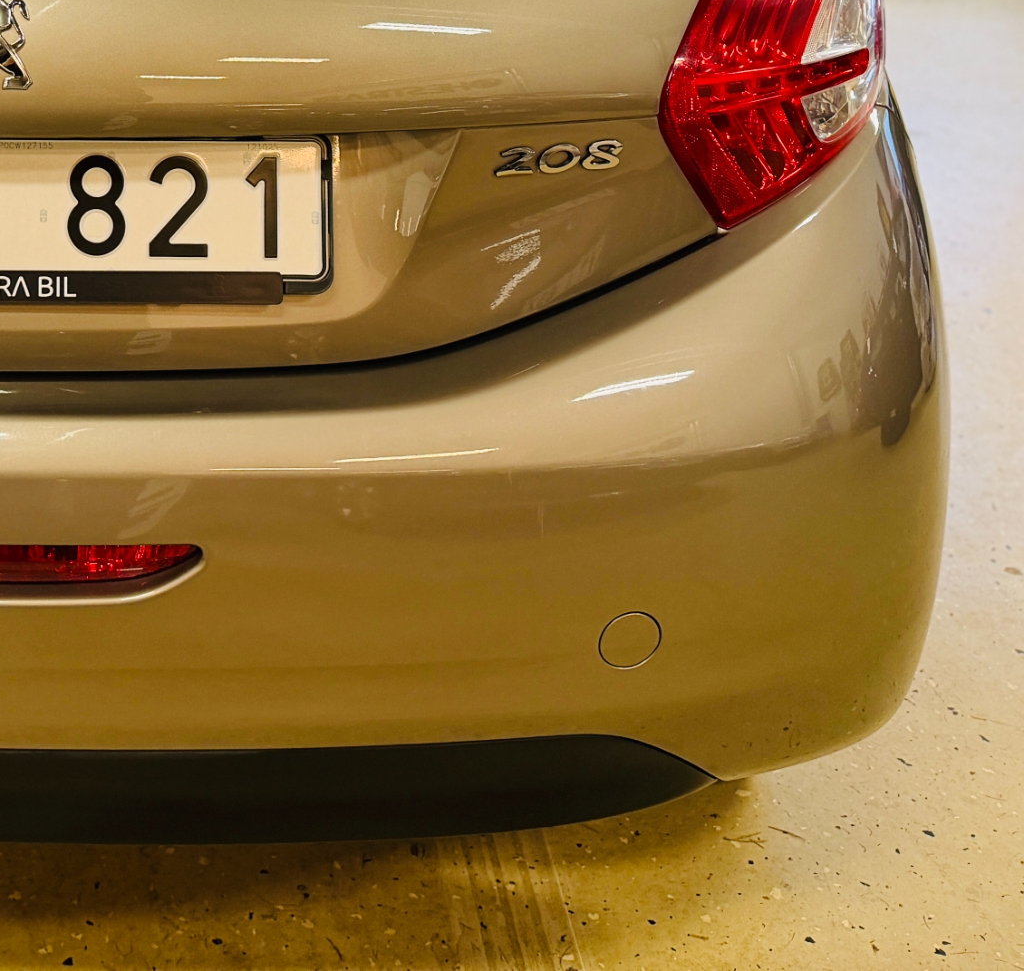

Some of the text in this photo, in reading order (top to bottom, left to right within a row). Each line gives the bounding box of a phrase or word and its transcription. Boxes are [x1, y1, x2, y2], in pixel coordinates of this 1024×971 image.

[494, 139, 624, 177] 208
[67, 155, 279, 259] 821
[37, 276, 77, 298] BIL
